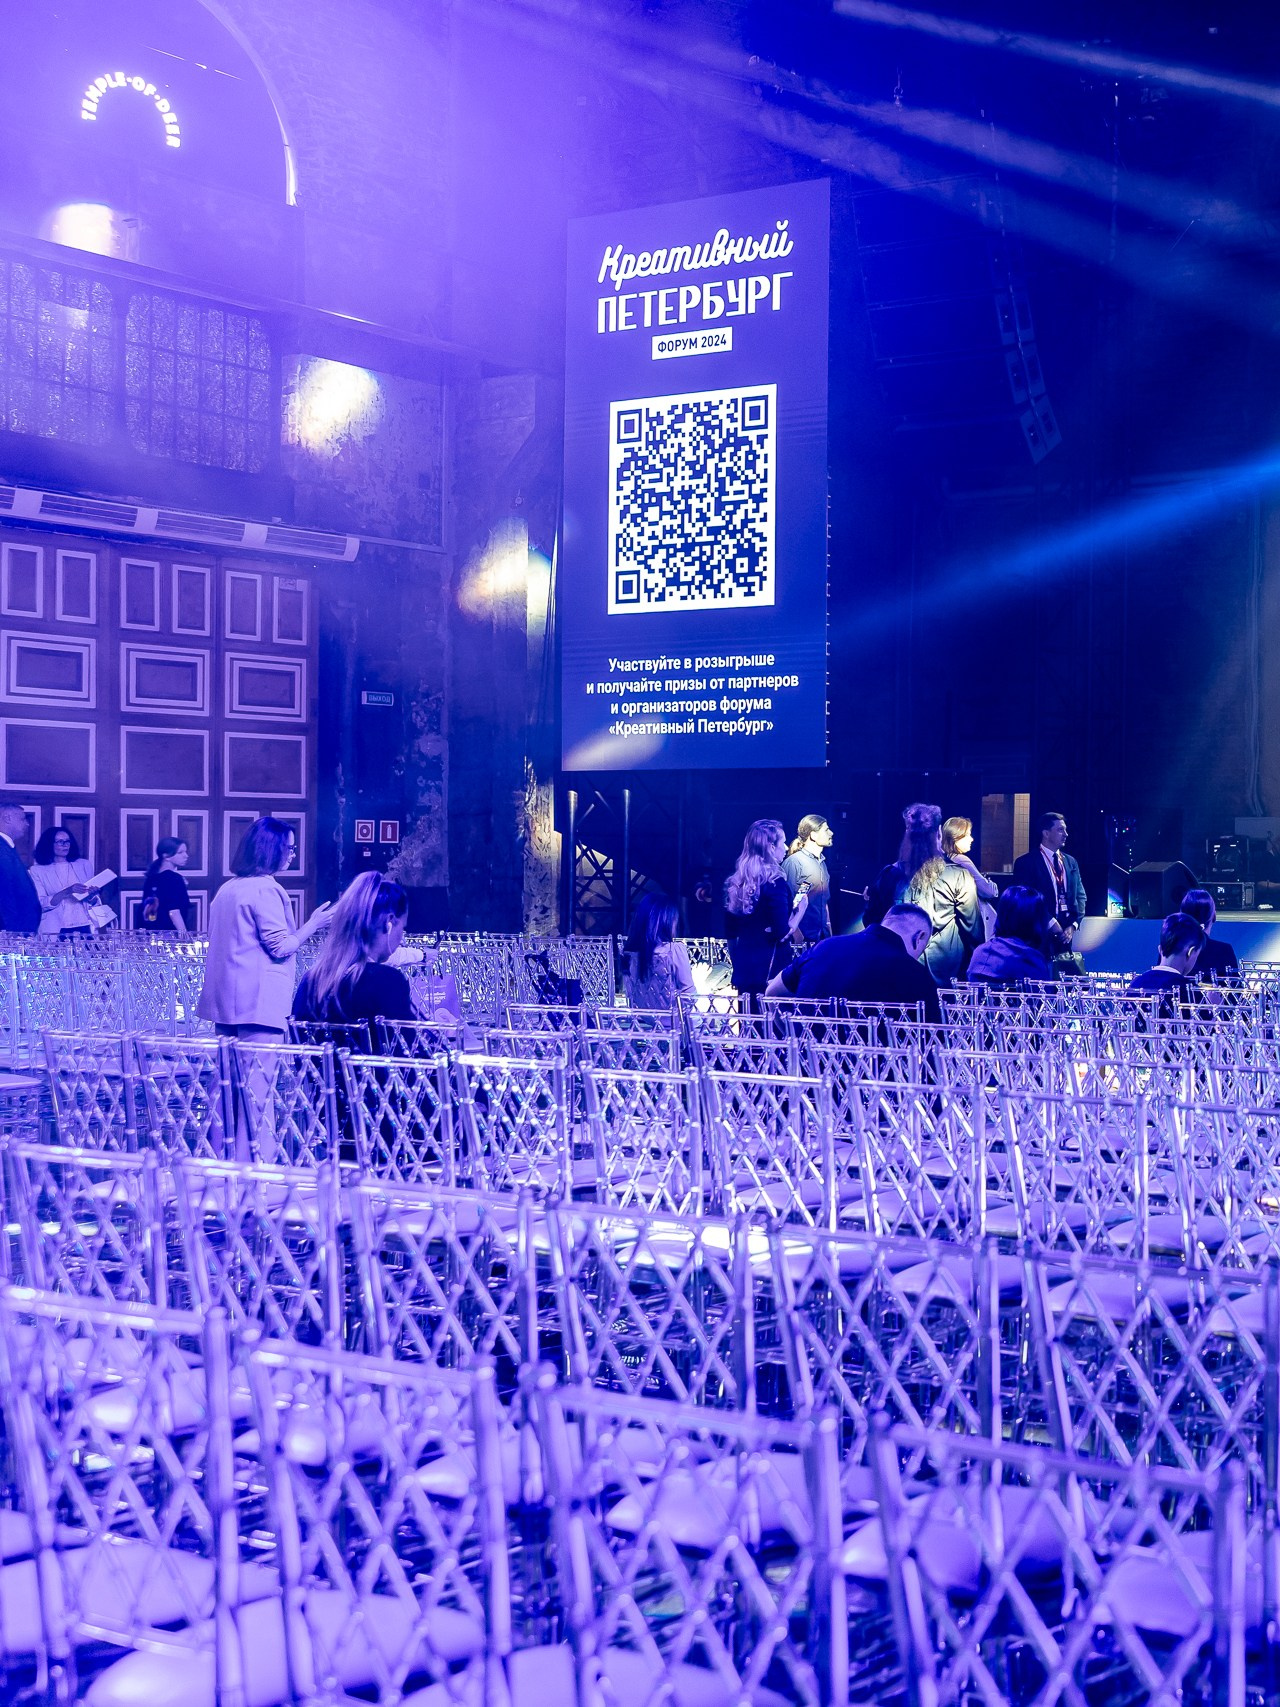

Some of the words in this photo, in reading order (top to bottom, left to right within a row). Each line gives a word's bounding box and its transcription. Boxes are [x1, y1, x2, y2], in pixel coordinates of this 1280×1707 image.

[597, 219, 795, 291] Креативный
[597, 271, 793, 334] ПЕТЕРБУРГ
[657, 335, 698, 353] ФОРУМ
[701, 333, 727, 349] 2024
[608, 655, 681, 674] Участвуйте
[683, 657, 692, 669] в
[695, 653, 775, 672] розыгрыше
[586, 682, 594, 694] и
[597, 677, 662, 697] получайте
[665, 678, 706, 695] призы
[709, 678, 725, 690] от
[728, 675, 799, 692] партнеров
[610, 702, 619, 714] и
[621, 699, 717, 717] организаторов
[720, 696, 772, 714] форума
[608, 718, 695, 739] «Креативный
[698, 717, 774, 735] Петербург»
